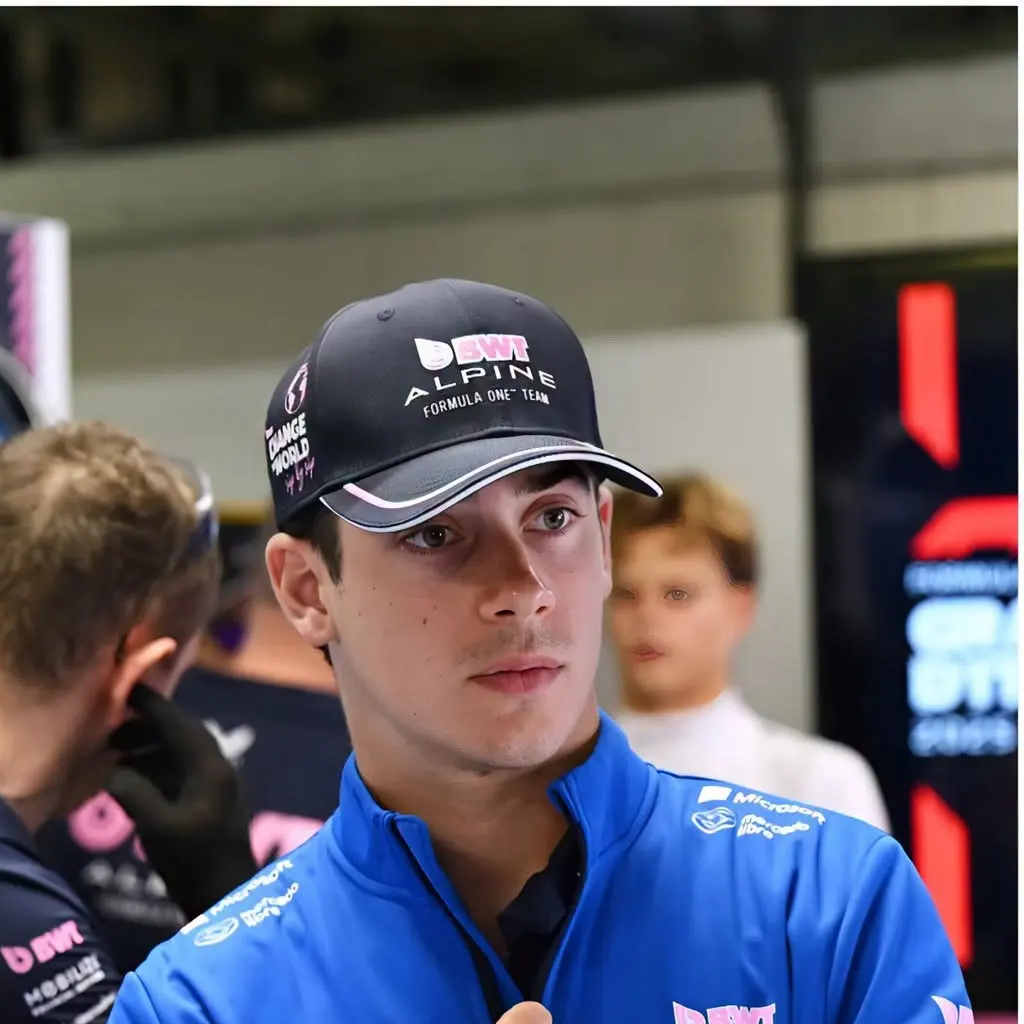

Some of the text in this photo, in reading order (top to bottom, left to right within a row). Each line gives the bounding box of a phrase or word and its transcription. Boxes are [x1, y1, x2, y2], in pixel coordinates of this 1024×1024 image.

[452, 333, 530, 365] BWT
[404, 364, 557, 407] ALPINE
[423, 392, 483, 418] FORMULA
[522, 388, 550, 405] TEAM
